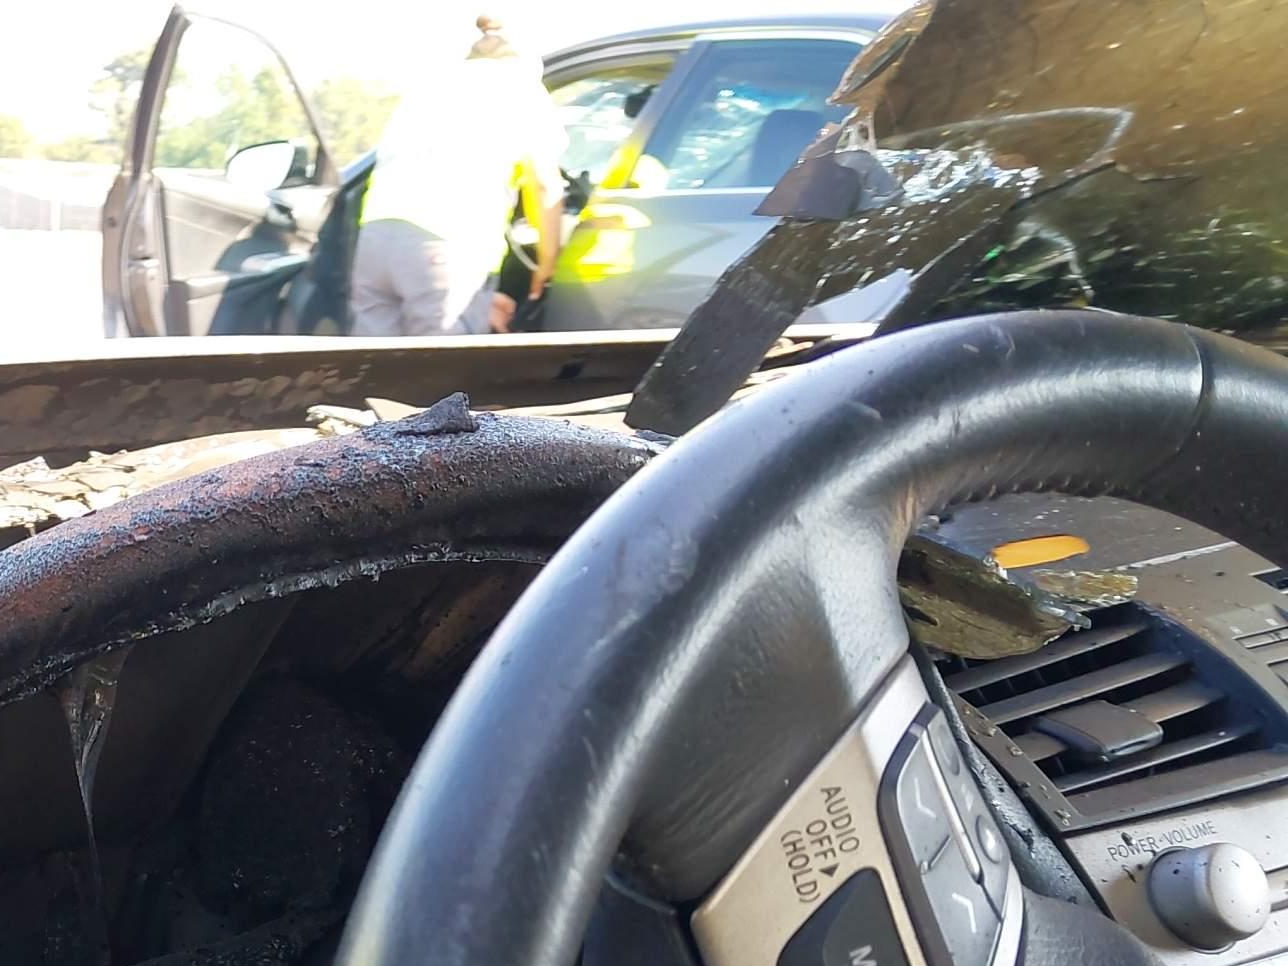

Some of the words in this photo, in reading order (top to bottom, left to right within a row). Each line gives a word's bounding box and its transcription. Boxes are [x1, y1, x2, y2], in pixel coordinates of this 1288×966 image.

[806, 819, 837, 860] OFF
[820, 786, 860, 853] AUDIO
[780, 830, 821, 903] (HOLD)
